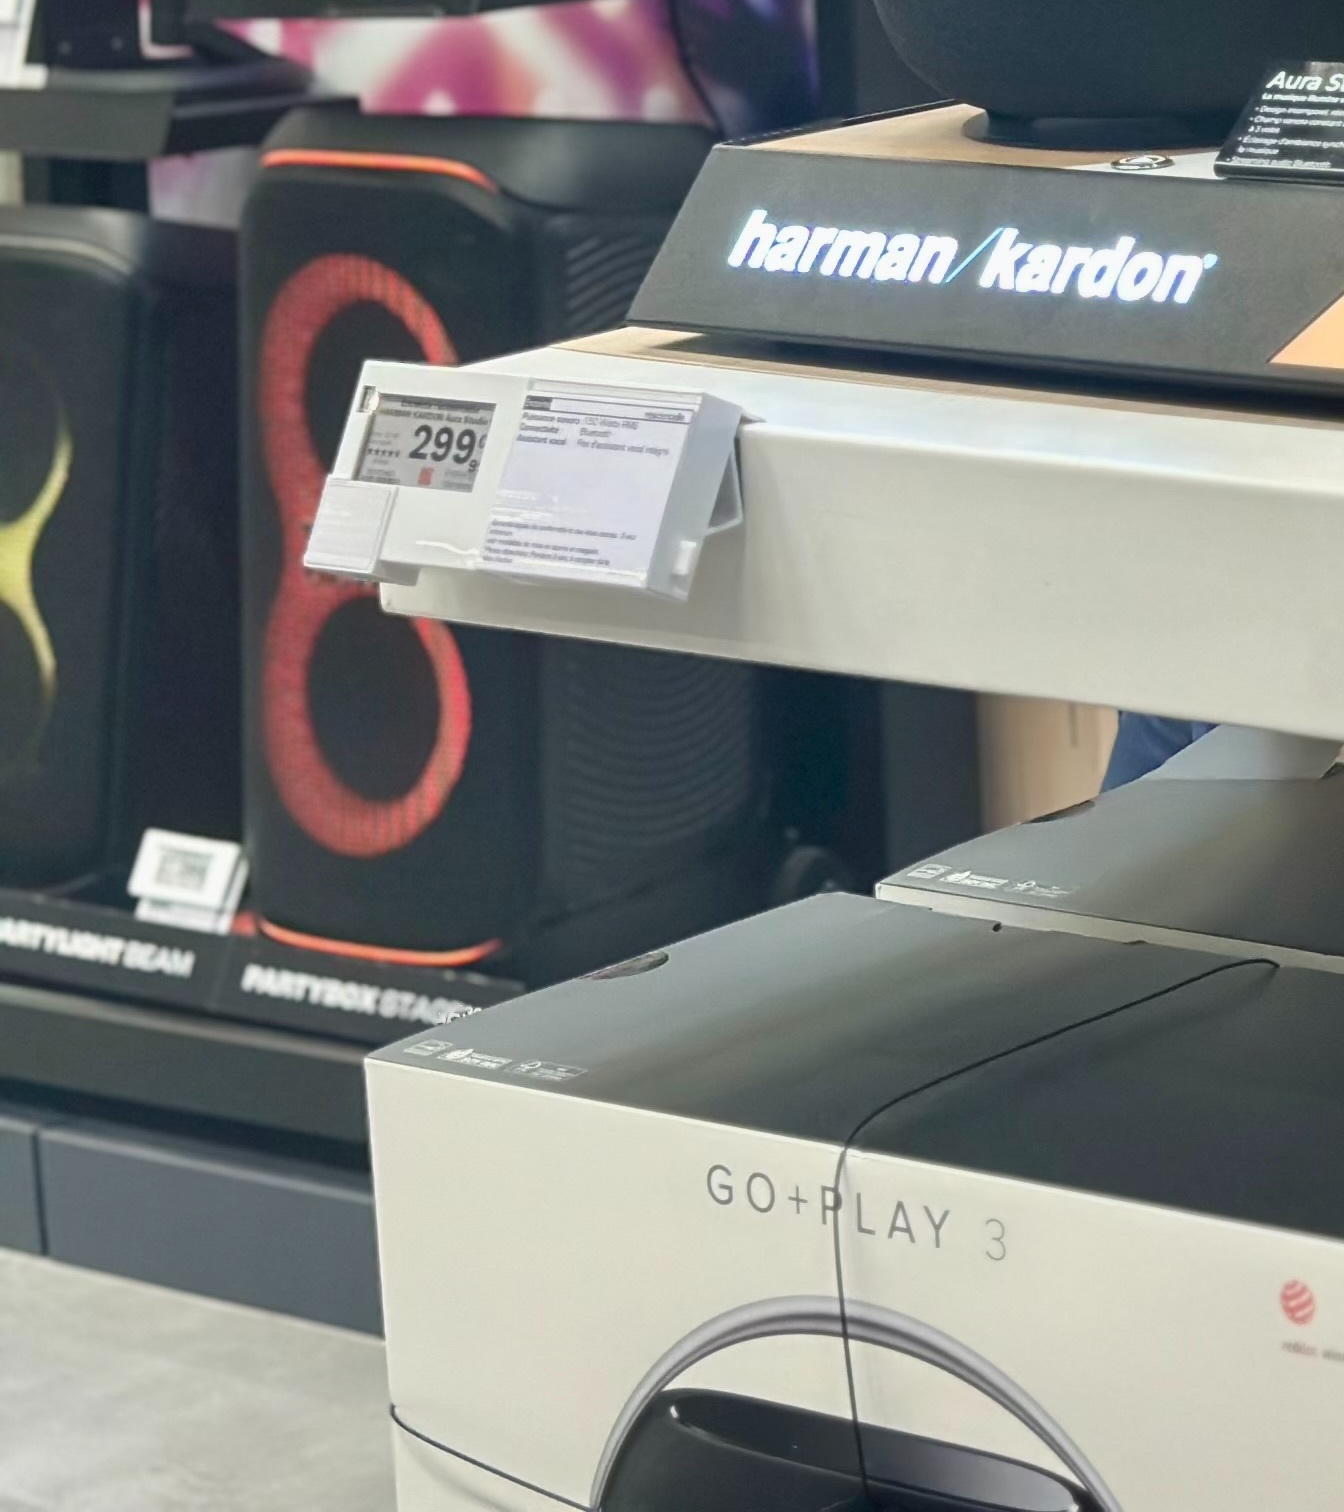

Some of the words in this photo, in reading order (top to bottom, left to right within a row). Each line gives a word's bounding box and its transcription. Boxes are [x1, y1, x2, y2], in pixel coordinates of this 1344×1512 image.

[1265, 71, 1322, 90] Aura
[408, 424, 477, 465] 299
[984, 1218, 1008, 1262] 3
